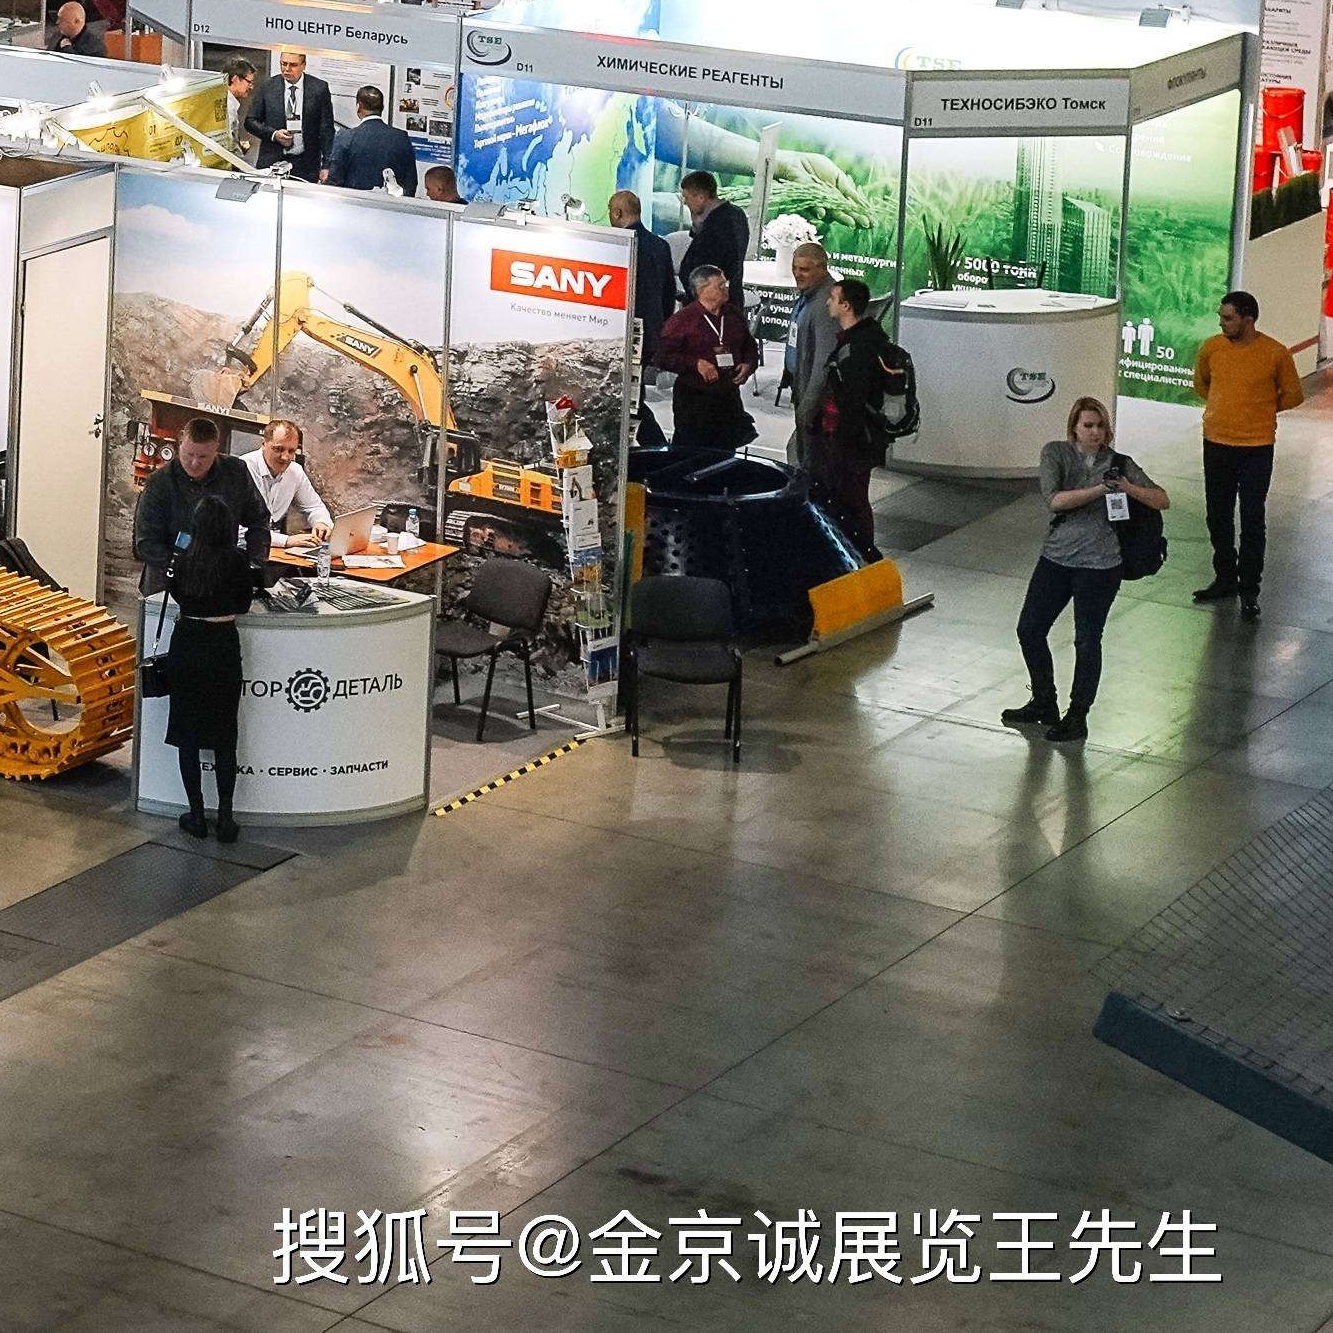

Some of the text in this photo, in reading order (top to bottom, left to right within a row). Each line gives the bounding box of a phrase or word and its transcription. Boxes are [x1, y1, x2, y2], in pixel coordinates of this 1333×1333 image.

[193, 23, 210, 34] D12
[265, 16, 409, 46] НПО ЦЕНТР Беларусь
[477, 35, 502, 45] TSE
[516, 63, 533, 72] D11
[597, 55, 783, 89] ХИМИЧЕСКИЕ РЕАГЕНТЫ
[941, 96, 1106, 112] ТЕХНОСИБЭКО Томск
[914, 117, 933, 127] D11
[509, 261, 613, 298] SANY
[509, 302, 609, 327] Качество меняет Мир
[343, 336, 377, 356] SANY
[1156, 347, 1174, 359] 50
[241, 673, 403, 699] ТОР ДЕТАЛЬ
[199, 760, 389, 776] ЕХКА СЕРВИС ЗАПЧАСТИ
